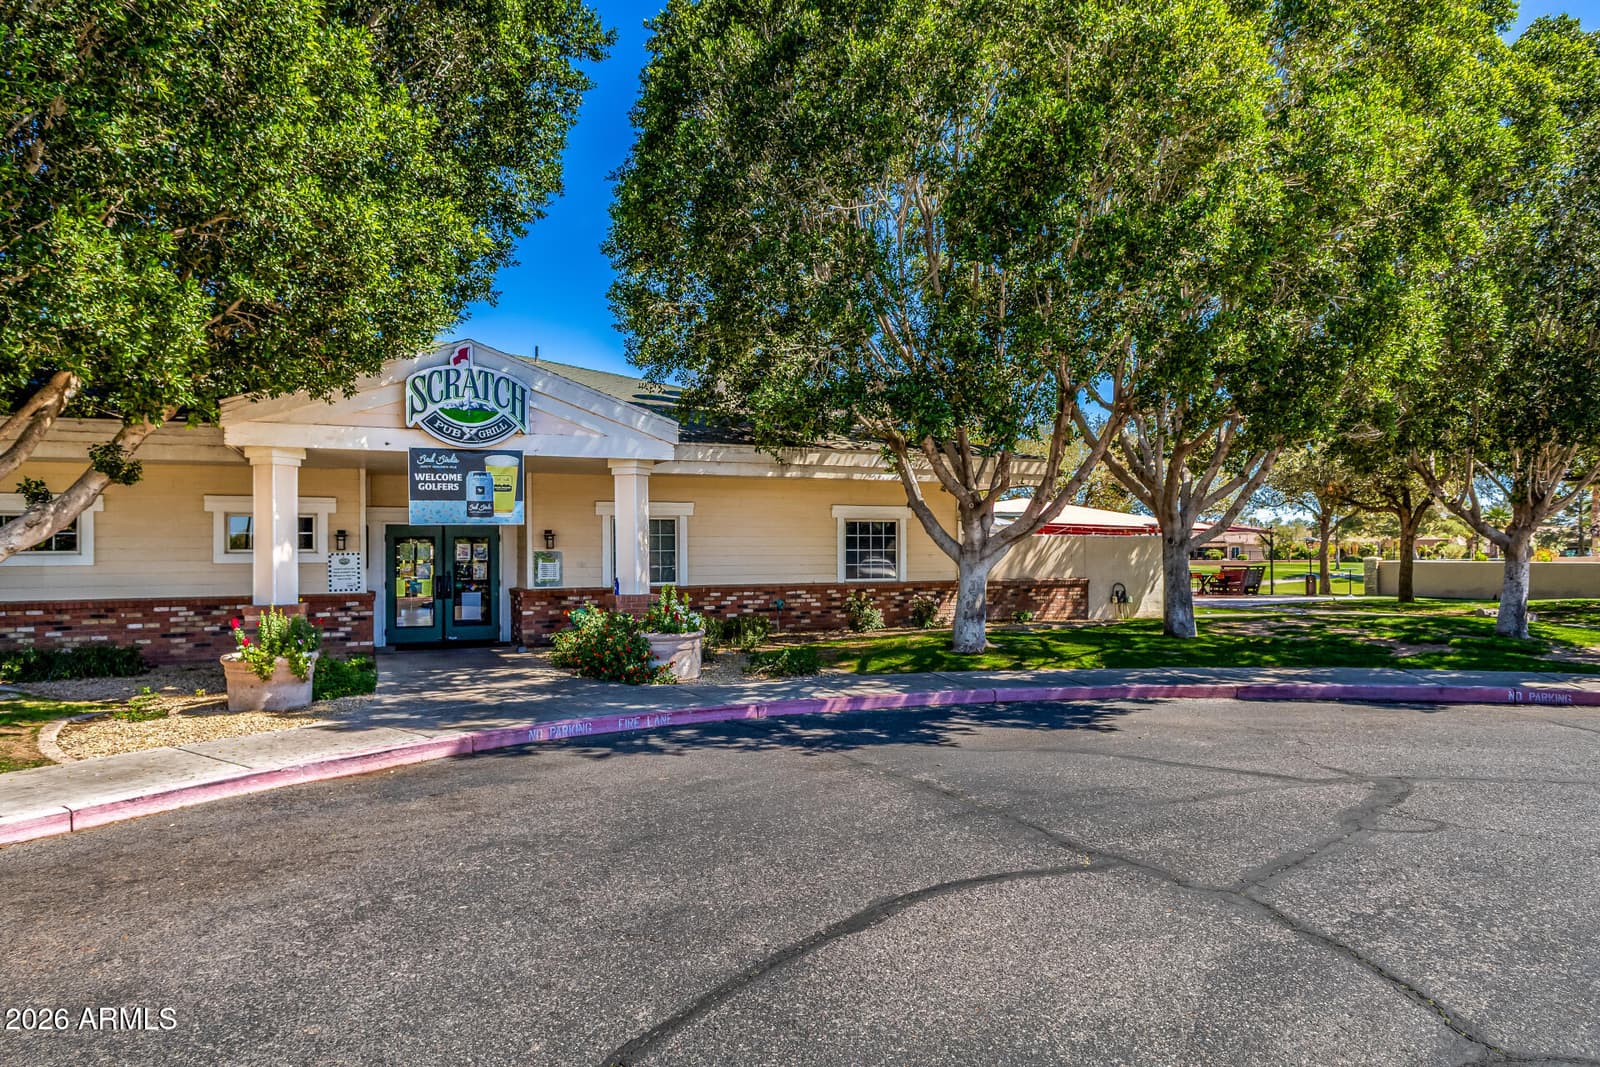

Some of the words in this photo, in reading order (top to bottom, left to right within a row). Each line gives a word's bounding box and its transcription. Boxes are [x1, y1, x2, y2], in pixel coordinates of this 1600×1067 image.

[408, 368, 527, 431] SCRATCH
[433, 420, 461, 437] PUB
[478, 424, 507, 439] GRILL
[414, 473, 463, 482] WELCOME
[418, 482, 459, 491] GOLFERS
[1508, 690, 1523, 702] NO
[1528, 692, 1572, 704] PARKING
[618, 716, 641, 729] FIRE
[646, 713, 673, 728] LANE
[528, 728, 543, 742] NO
[549, 722, 593, 739] PARKING
